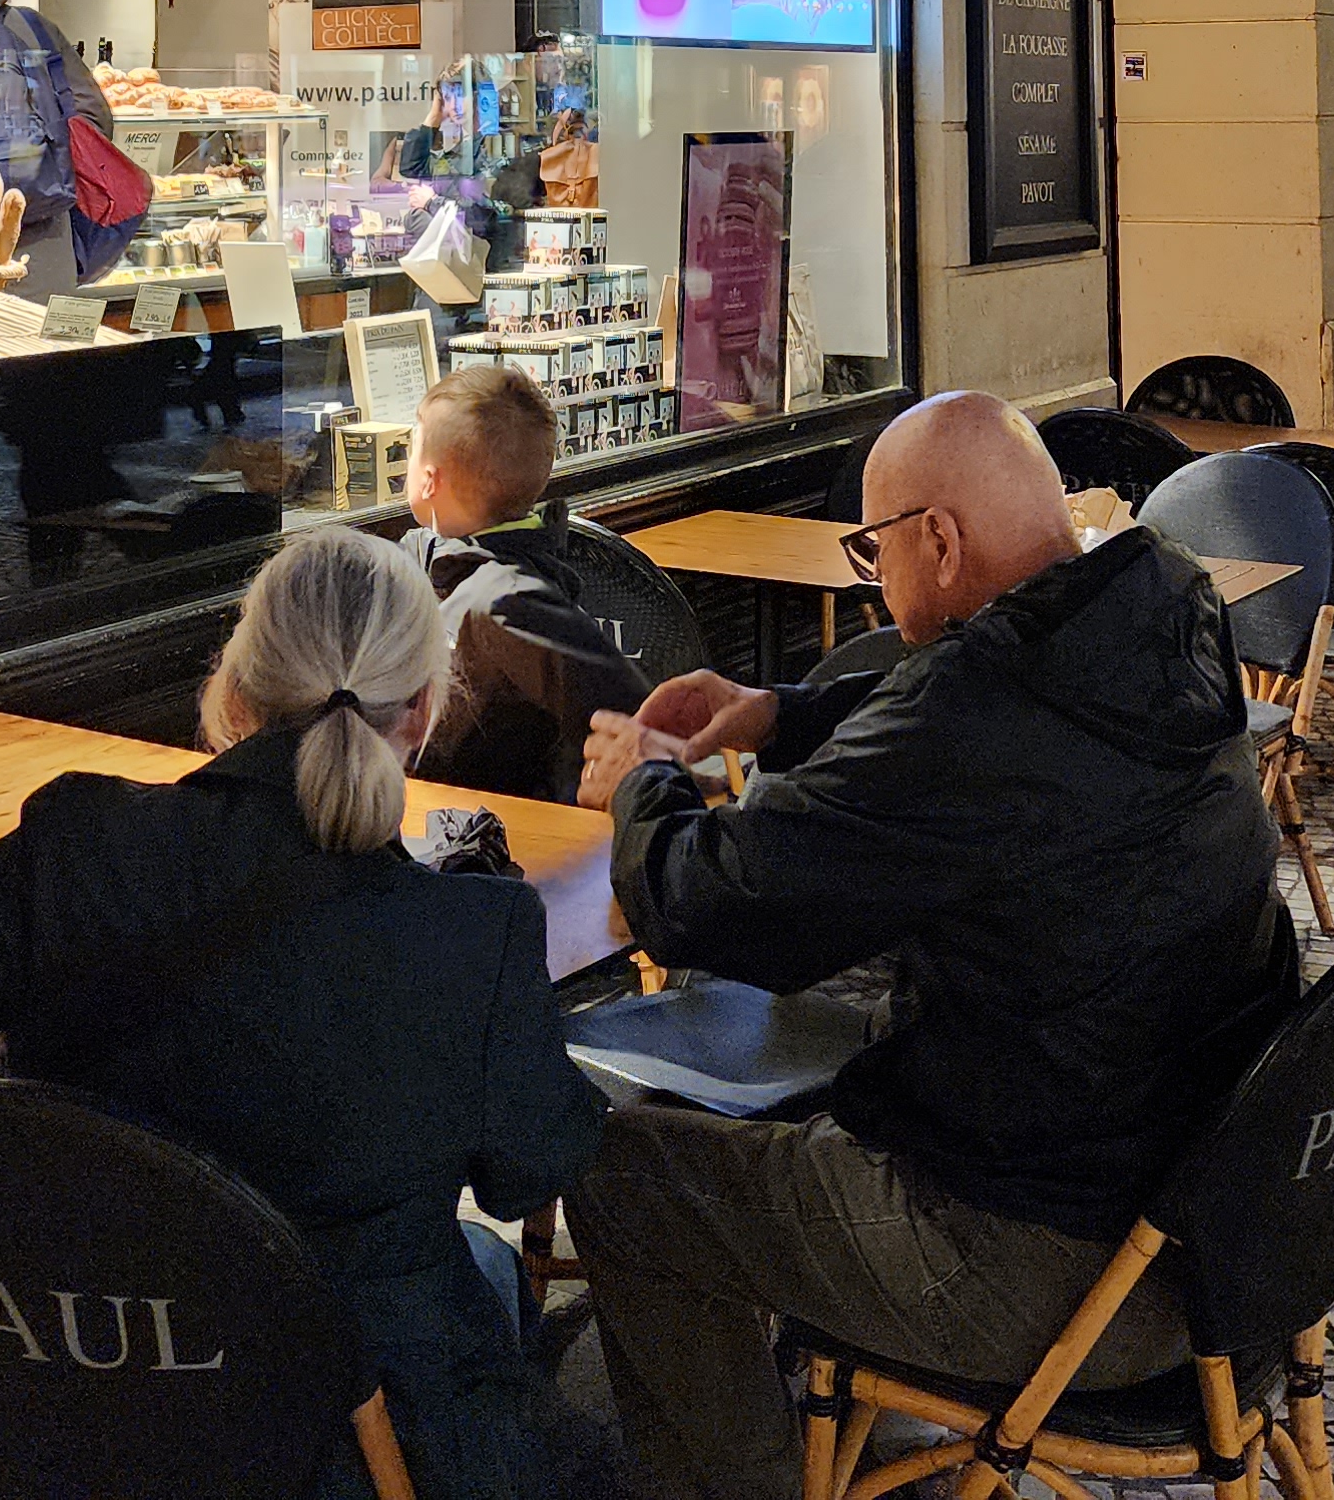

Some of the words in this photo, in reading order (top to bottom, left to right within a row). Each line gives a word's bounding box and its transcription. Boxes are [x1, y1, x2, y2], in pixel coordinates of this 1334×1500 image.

[320, 9, 377, 28] CLICK
[379, 11, 396, 26] &
[321, 24, 415, 47] COLLECT
[1002, 33, 1017, 54] LA
[1019, 34, 1068, 57] FOUGASSE
[296, 81, 438, 107] www.paul.fr
[1012, 82, 1060, 103] COMPLET
[125, 132, 161, 145] MERCI
[290, 150, 364, 162] Commadez
[1021, 181, 1056, 204] PAVOT
